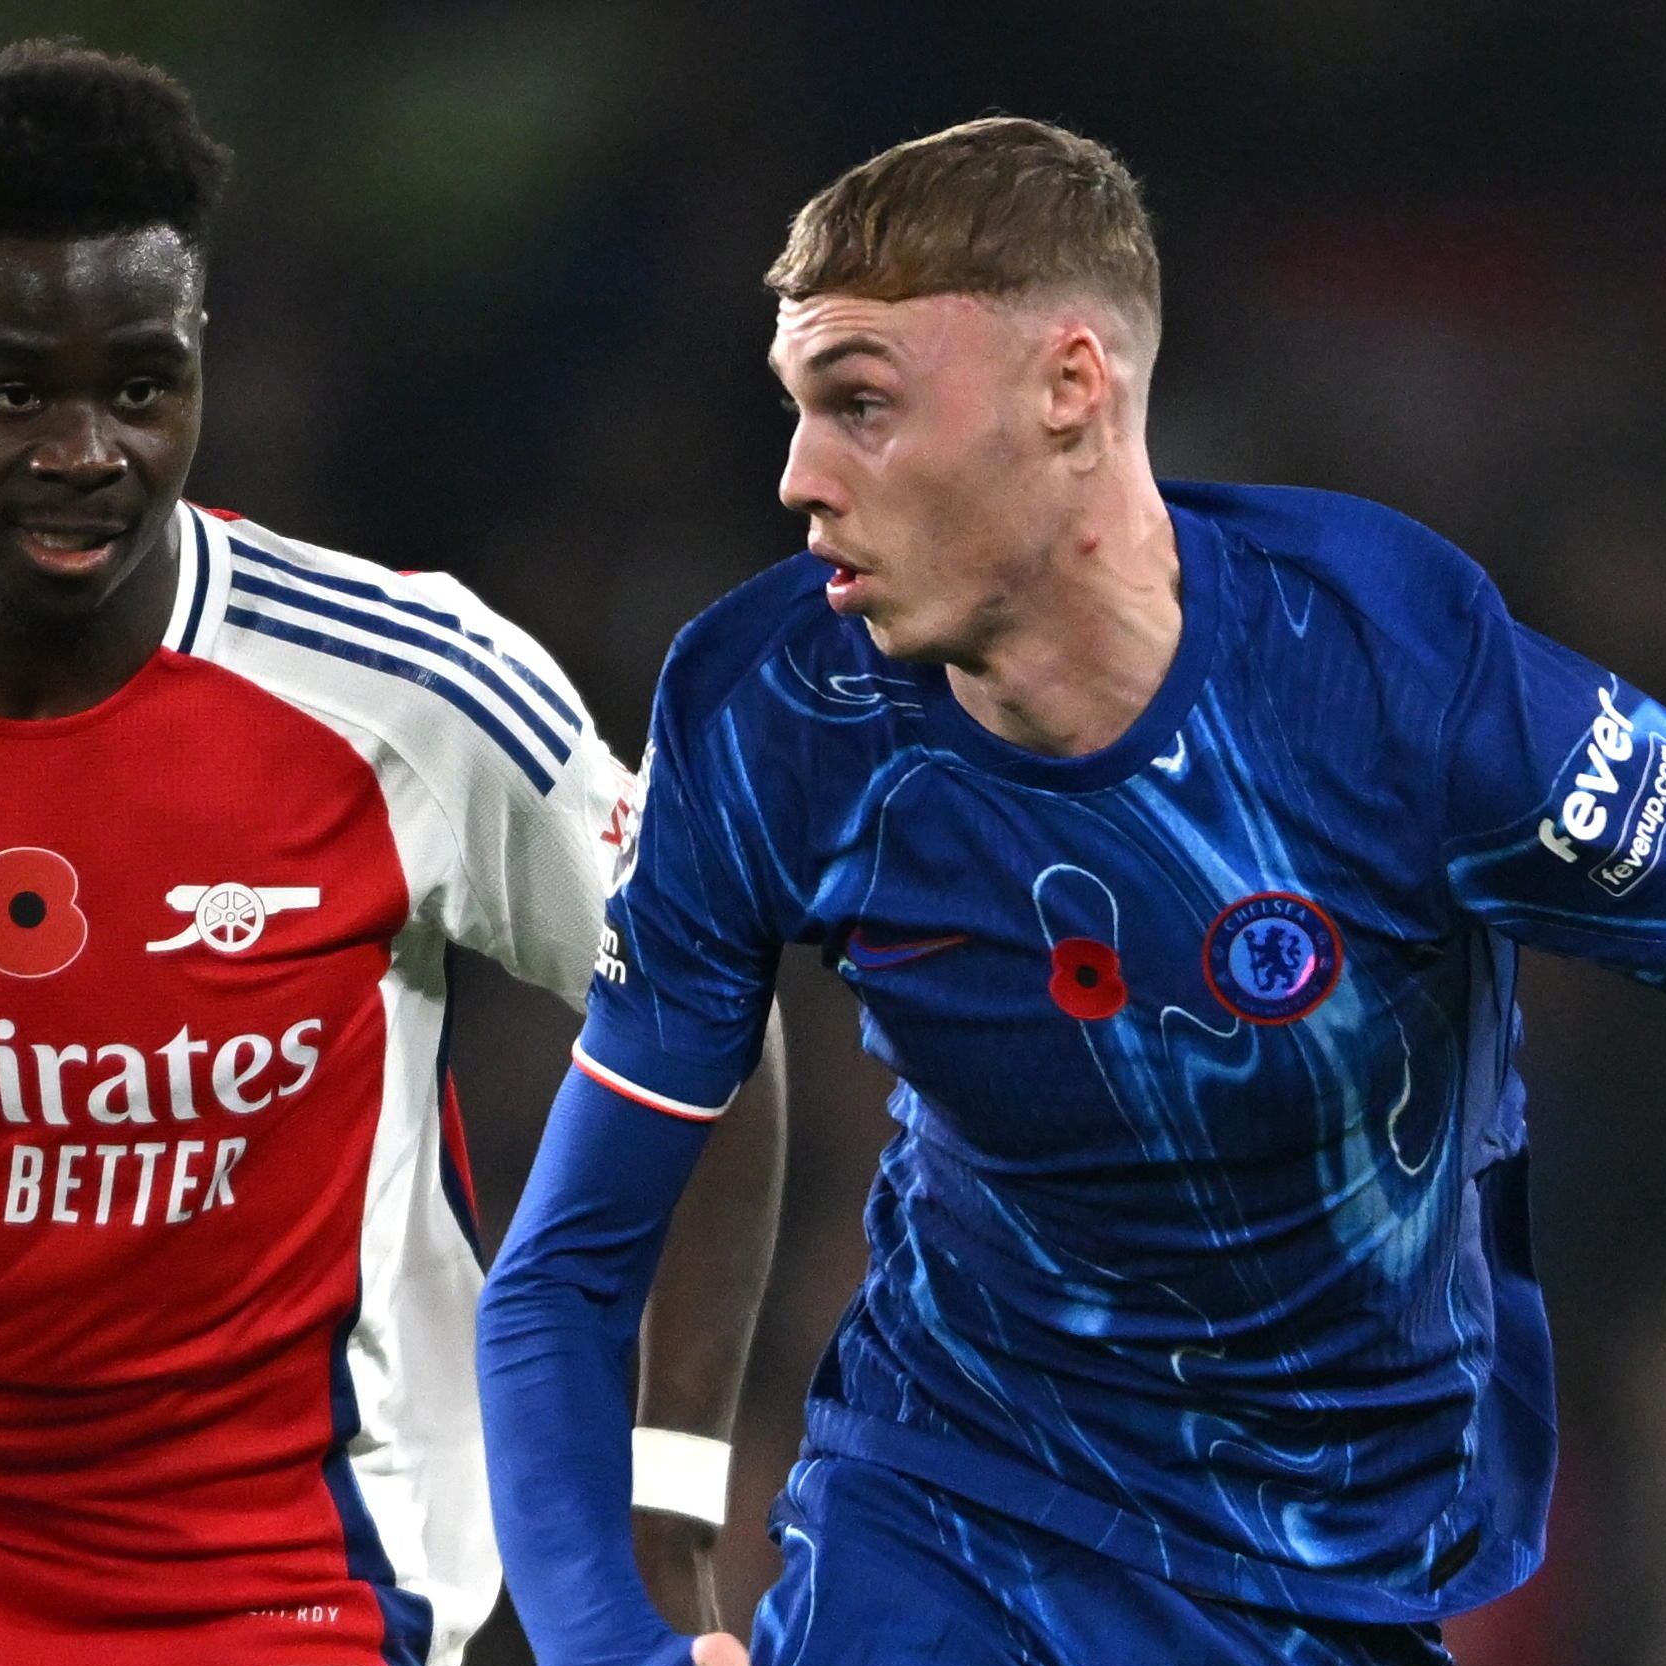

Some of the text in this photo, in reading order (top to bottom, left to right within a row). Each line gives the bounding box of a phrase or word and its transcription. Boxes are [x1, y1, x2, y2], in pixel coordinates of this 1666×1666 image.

[1537, 686, 1634, 863] fever
[1224, 899, 1307, 932] CHELSEA
[4, 1136, 247, 1227] BETTER
